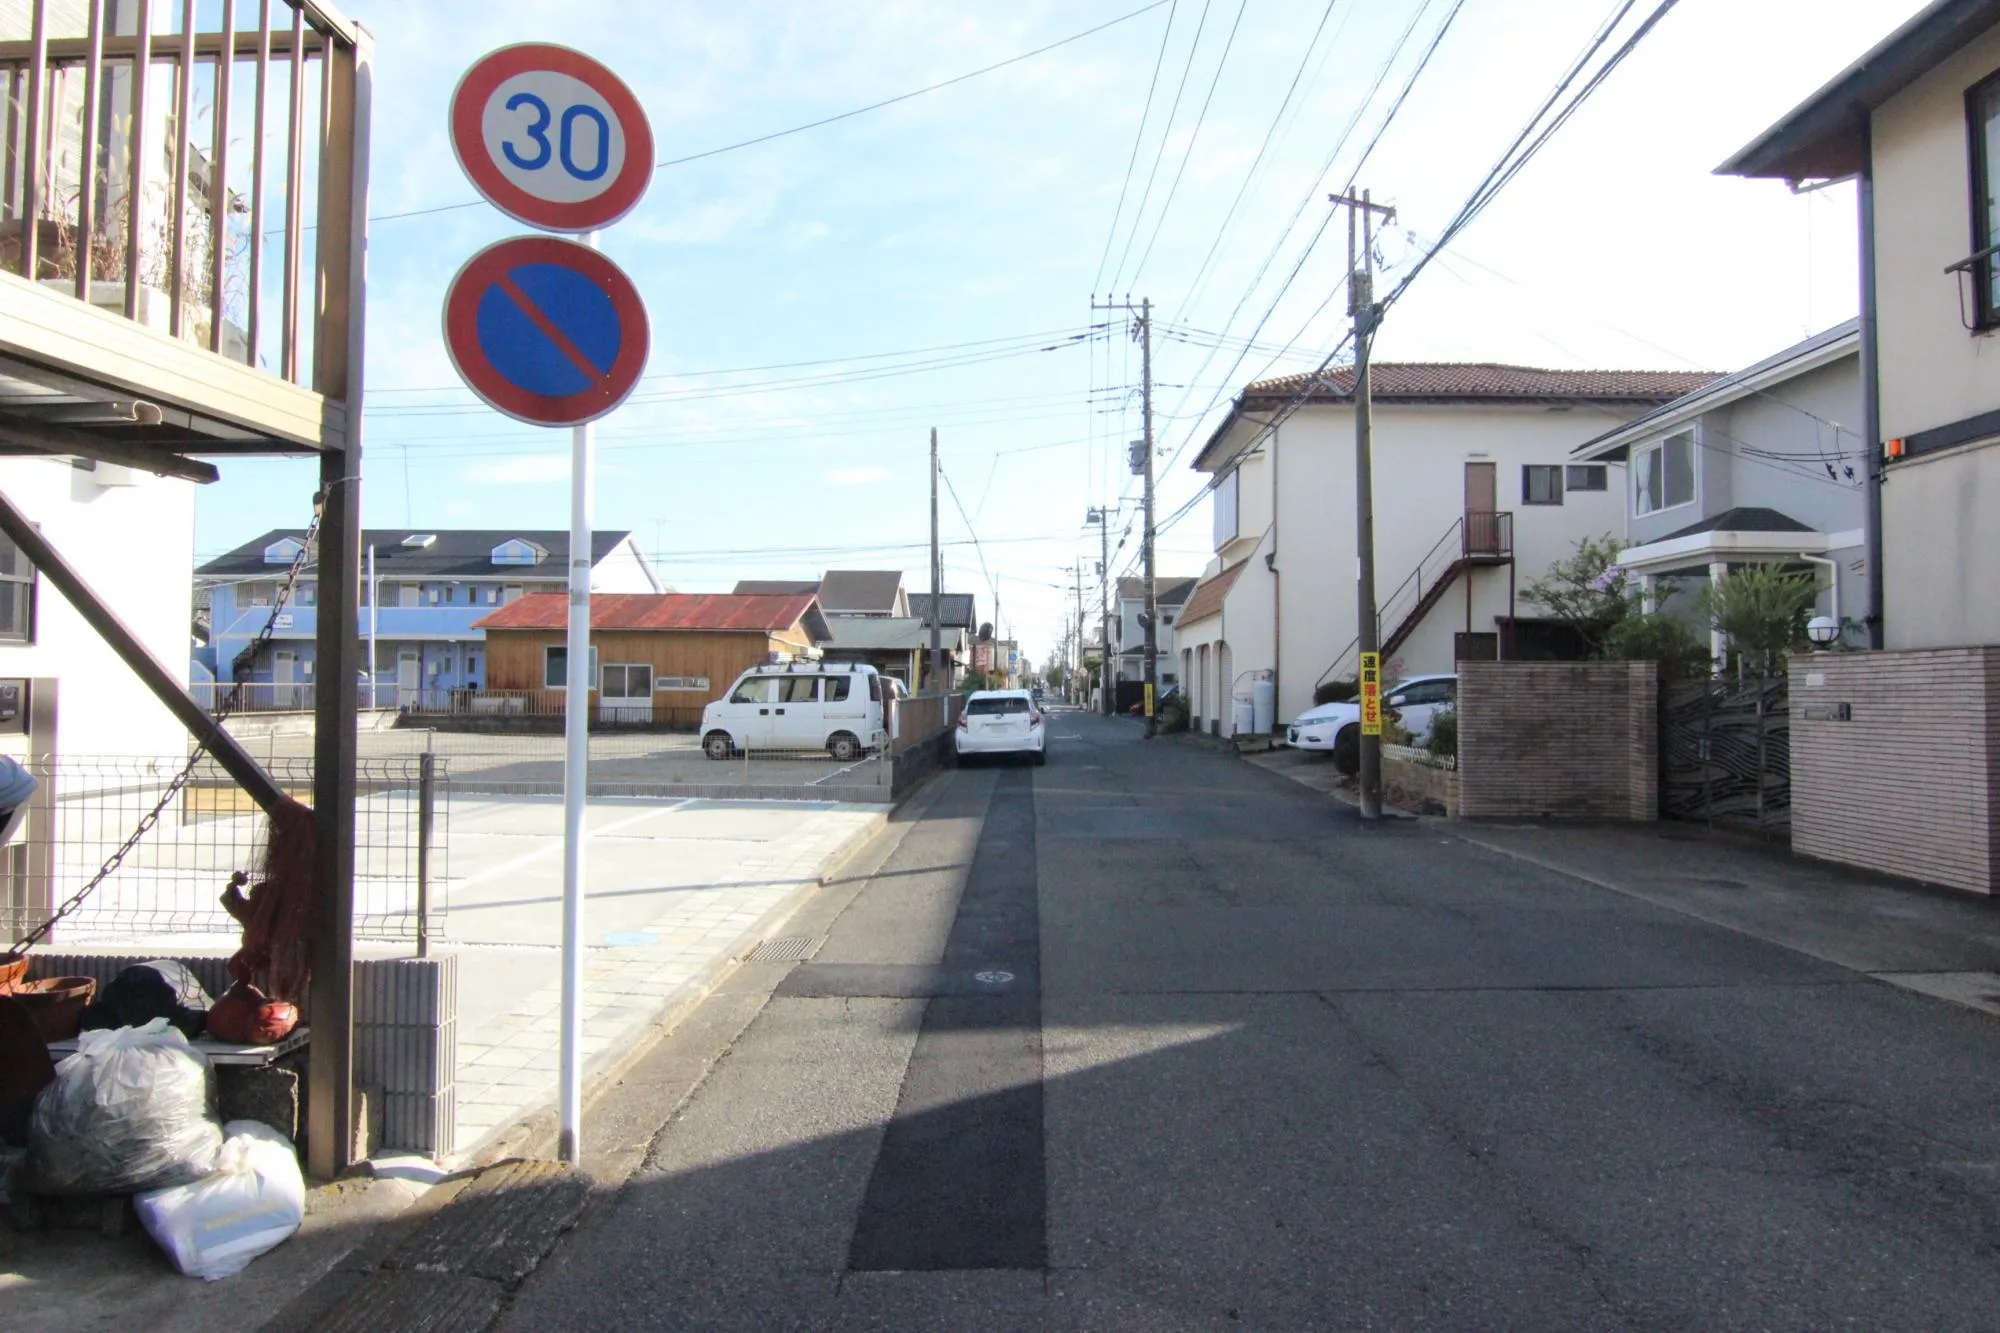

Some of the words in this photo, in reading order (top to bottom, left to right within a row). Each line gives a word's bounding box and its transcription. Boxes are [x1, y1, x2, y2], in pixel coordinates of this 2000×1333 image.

[502, 92, 609, 182] 30
[1363, 656, 1376, 722] 速度落とせ
